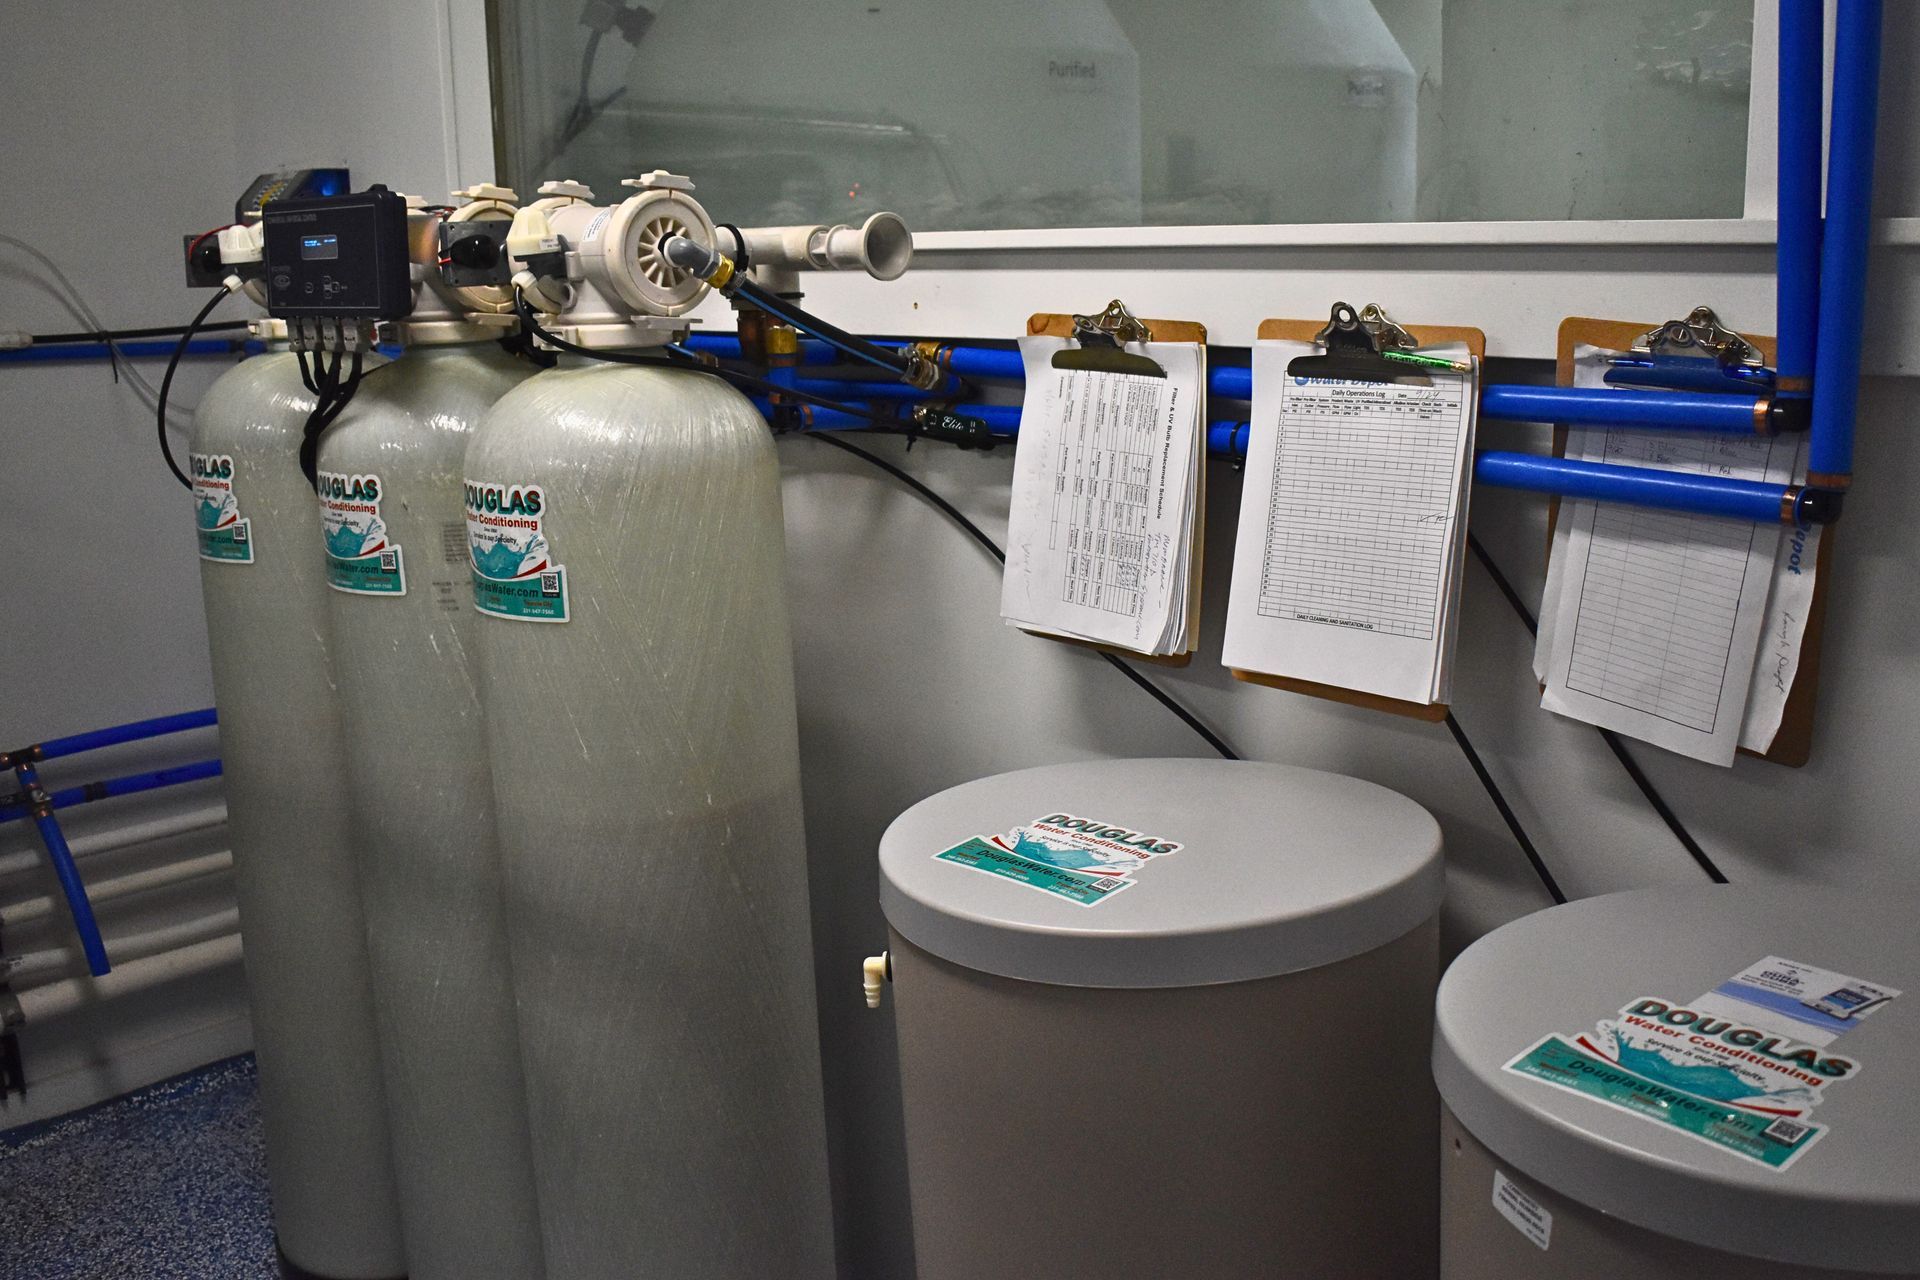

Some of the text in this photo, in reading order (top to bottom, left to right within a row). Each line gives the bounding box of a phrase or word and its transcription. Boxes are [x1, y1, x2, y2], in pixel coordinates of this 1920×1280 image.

[1049, 61, 1095, 78] Purified
[1332, 390, 1345, 398] Daily
[1346, 390, 1375, 398] Operations
[942, 416, 964, 430] Elite
[1168, 414, 1174, 423] UV
[190, 456, 232, 479] GLAS
[1160, 443, 1170, 486] Replacement
[320, 474, 379, 501] OUGLAS
[479, 514, 538, 531] Conditioning
[1340, 620, 1364, 628] SANITATION
[1033, 822, 1152, 860] Water Conditioning
[1039, 814, 1178, 854] DOUGLAS
[976, 850, 1086, 886] DouglasWater.com
[1626, 1000, 1853, 1078] DOUGLAS
[1626, 1015, 1824, 1087] Water Conditioning
[1646, 1038, 1684, 1054] Service
[1568, 1060, 1754, 1132] DouglasWater.com
